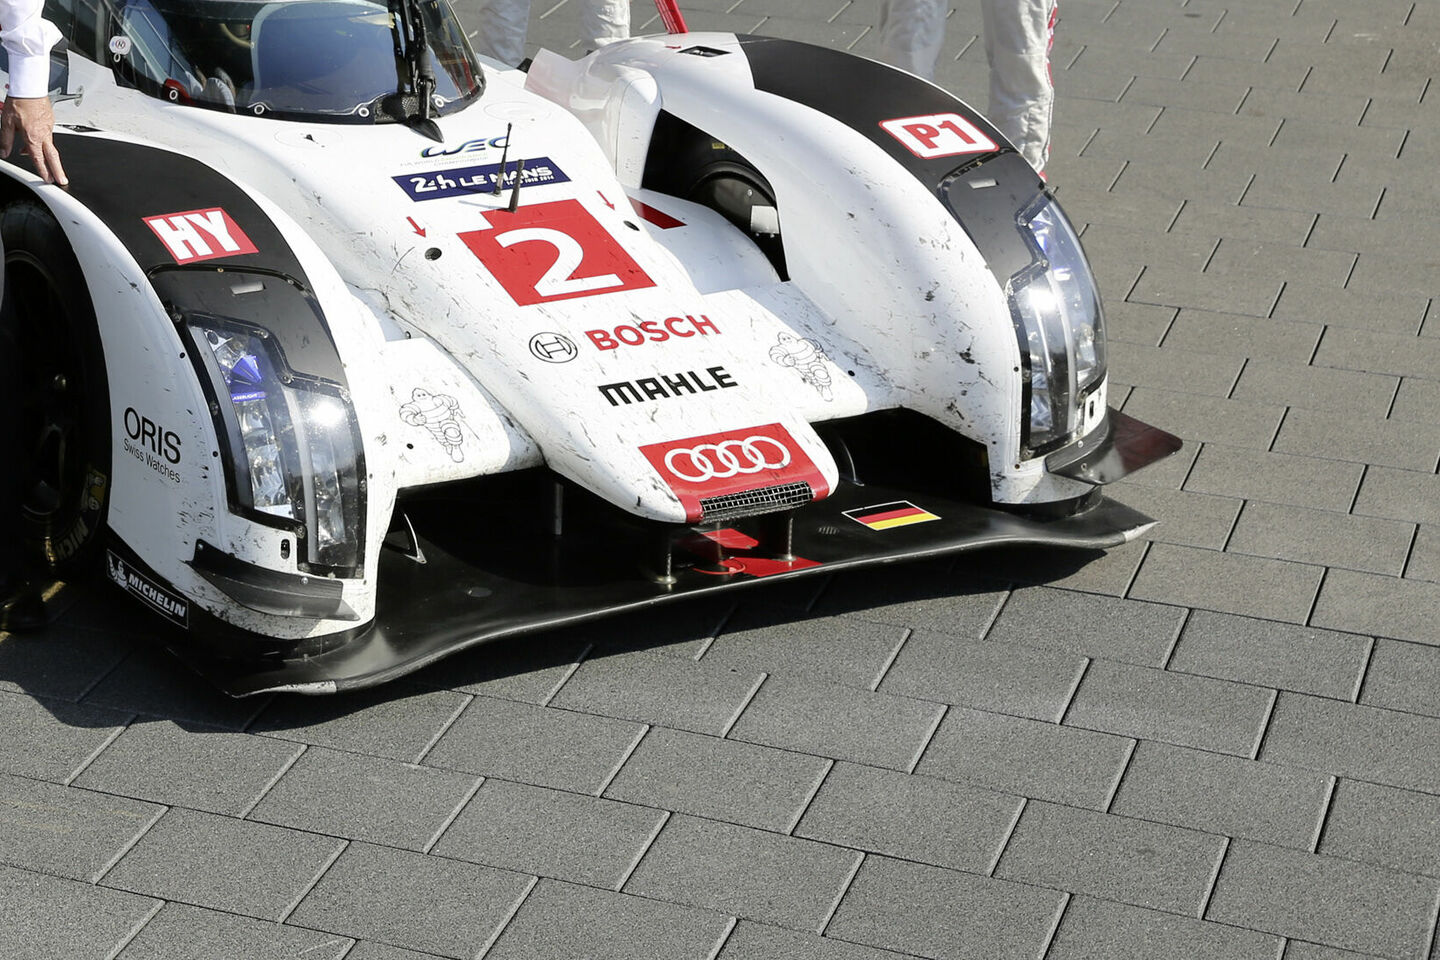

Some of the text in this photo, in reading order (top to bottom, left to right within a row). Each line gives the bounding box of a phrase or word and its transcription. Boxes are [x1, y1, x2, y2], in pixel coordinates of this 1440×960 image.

[420, 136, 511, 158] WEC
[904, 120, 979, 150] P1
[409, 173, 458, 193] 24h
[459, 174, 488, 188] LE
[489, 166, 553, 184] MANS
[148, 210, 241, 261] HY
[495, 227, 625, 298] 2
[584, 314, 722, 352] BOSCH
[598, 365, 739, 407] MAHLE
[124, 407, 182, 465] ORIS
[124, 438, 181, 483] Swiss Watches
[128, 573, 186, 618] MICHELIN
